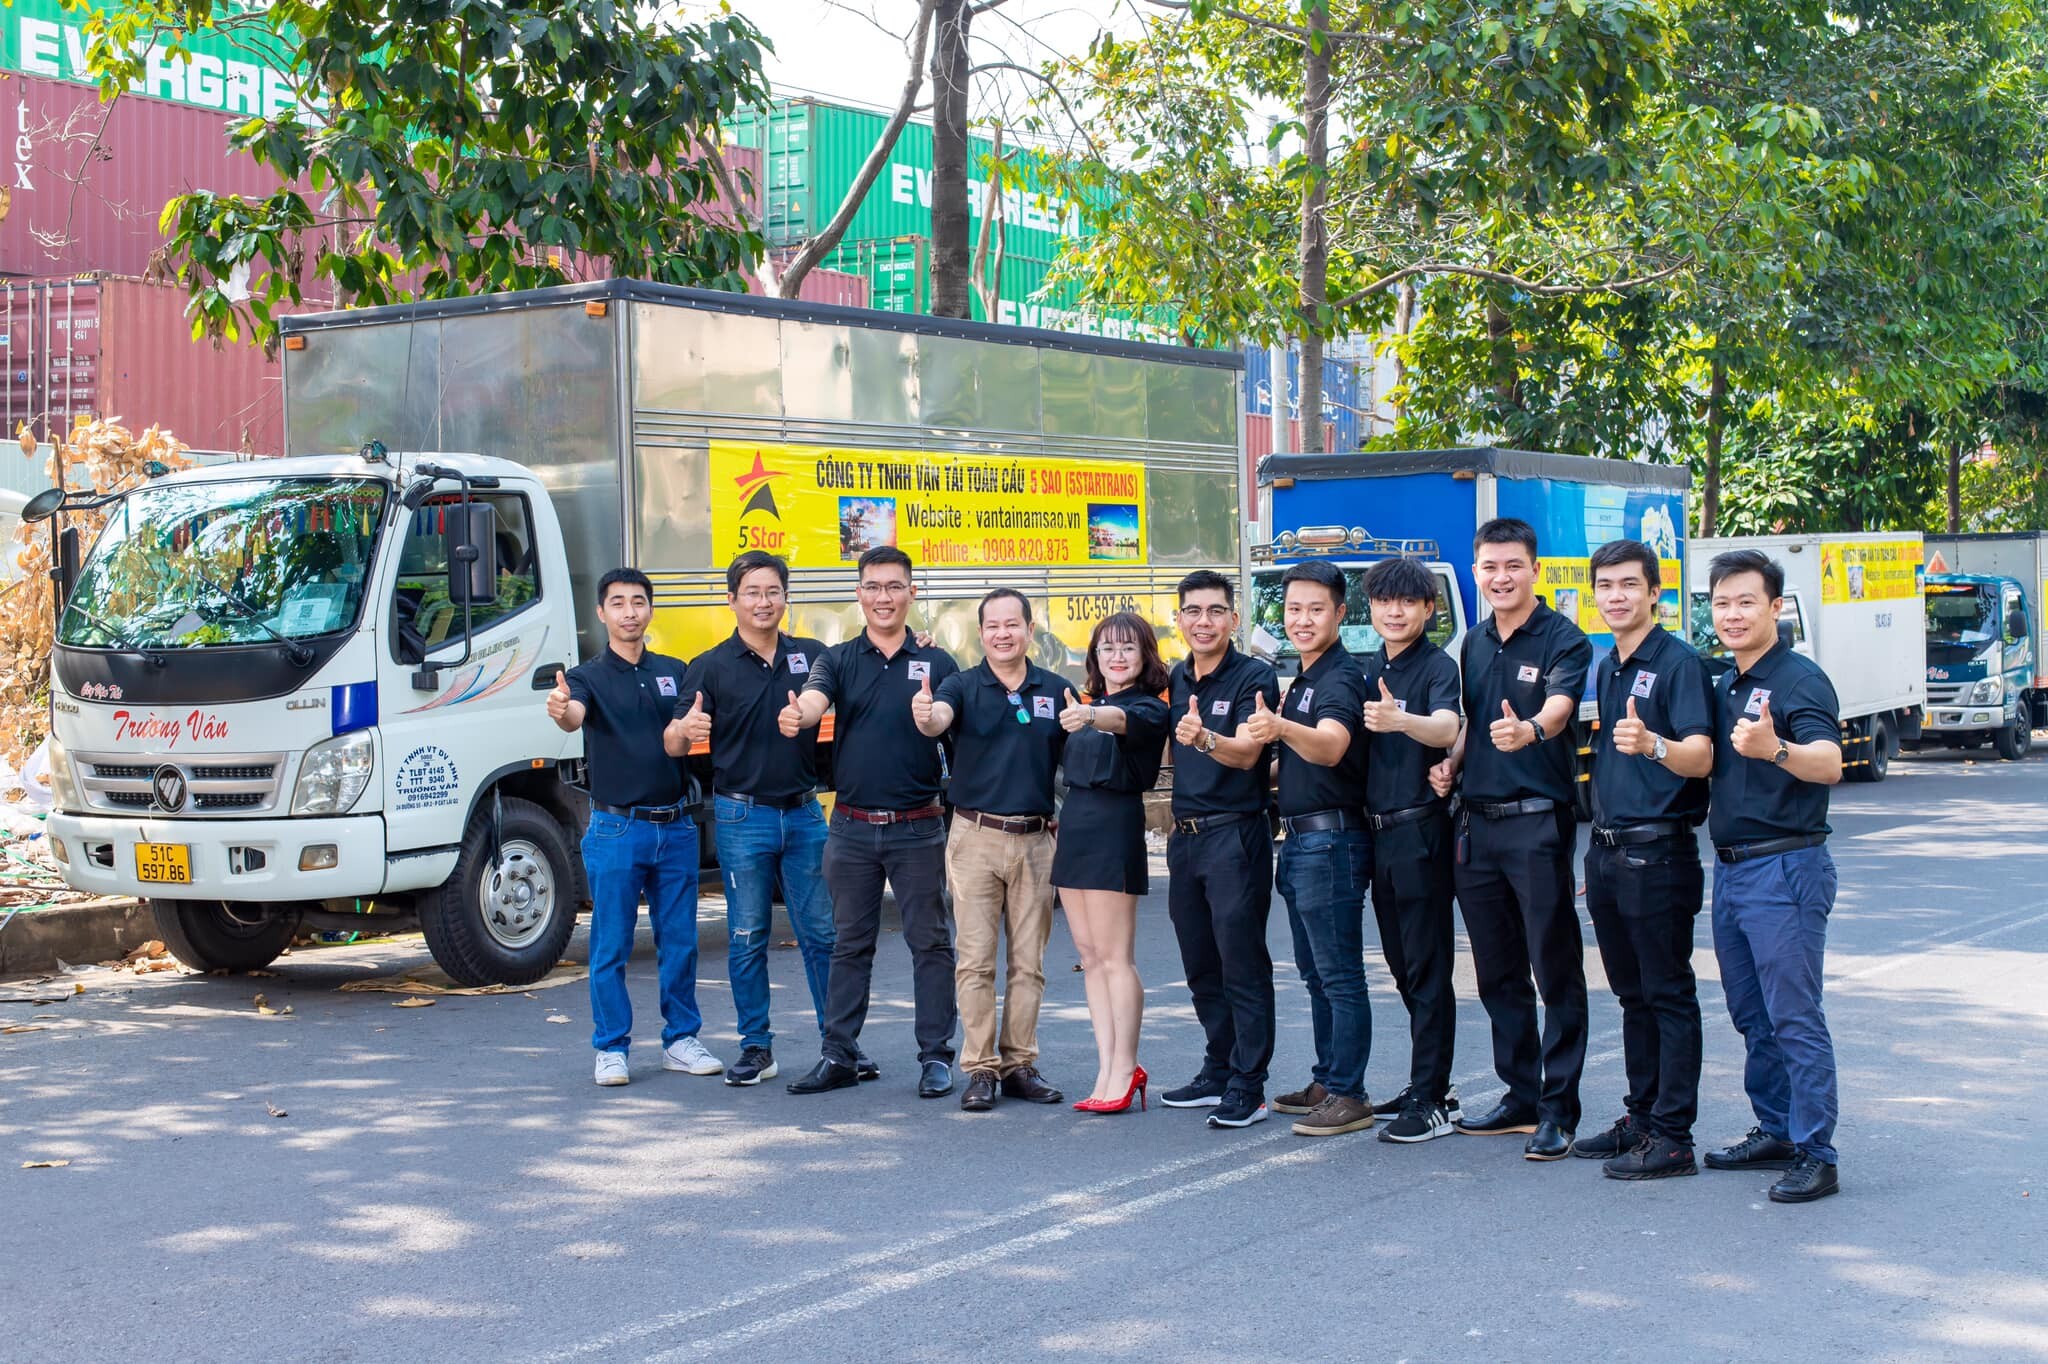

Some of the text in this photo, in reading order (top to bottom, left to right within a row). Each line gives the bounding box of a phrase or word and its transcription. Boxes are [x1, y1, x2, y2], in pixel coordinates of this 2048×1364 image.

[20, 16, 330, 128] EVRGREE
[14, 99, 35, 190] tex
[892, 163, 1080, 239] EVRREEN
[816, 454, 854, 489] CÔNG
[858, 462, 873, 489] TY
[877, 463, 911, 490] TNHH
[916, 460, 940, 496] VẬN
[944, 457, 963, 492] TẢI
[967, 462, 998, 493] TOÀN
[1030, 469, 1037, 494] 5
[1041, 469, 1062, 494] SAO
[1065, 471, 1138, 499] (5STARTRANS)
[906, 503, 962, 528] Website
[975, 506, 1081, 529] vantainamsao.vn
[922, 538, 969, 562] Hotline
[982, 538, 1069, 562] 0908.820.875
[112, 709, 229, 749] Trường Vân
[410, 777, 423, 785] TTT
[150, 845, 175, 862] 51C
[142, 863, 185, 882] 597.86
